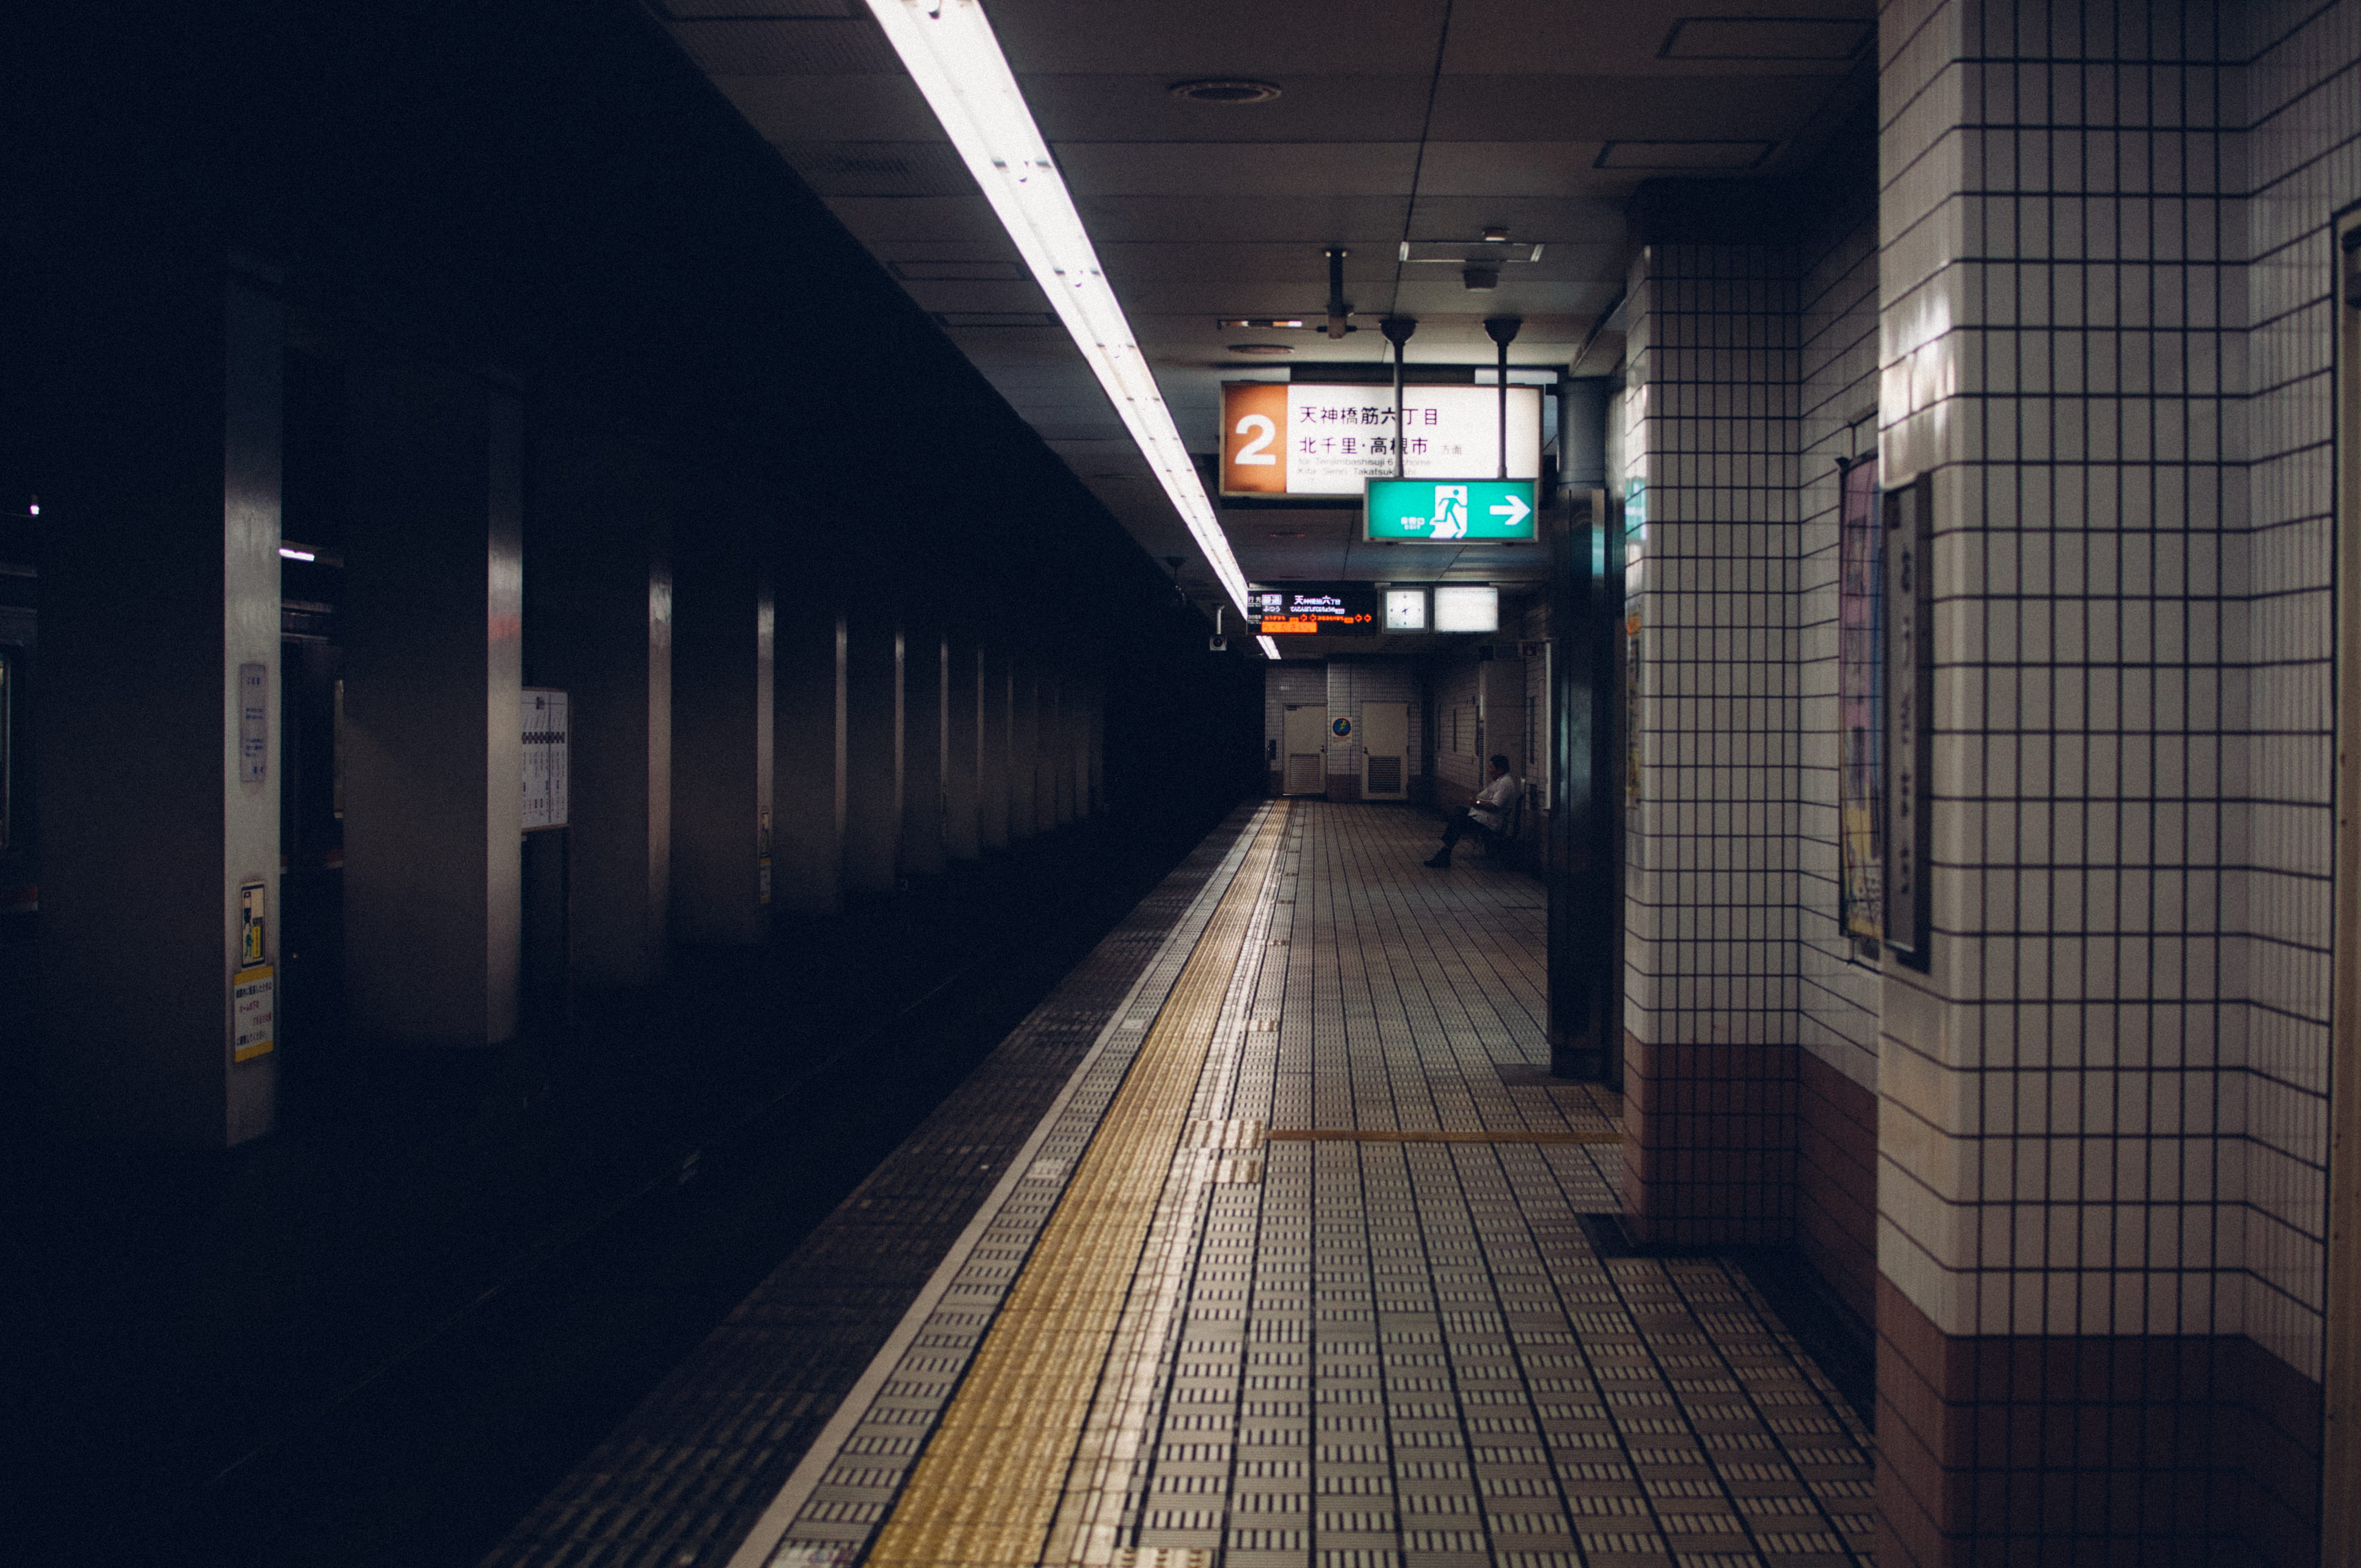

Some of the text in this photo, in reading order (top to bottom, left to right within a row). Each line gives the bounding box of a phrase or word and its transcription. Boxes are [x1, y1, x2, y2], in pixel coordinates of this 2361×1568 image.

[1299, 406, 1438, 426] 天神橋筋六丁目
[1234, 414, 1277, 465] 2
[1299, 437, 1428, 455] 北千里・高槻市
